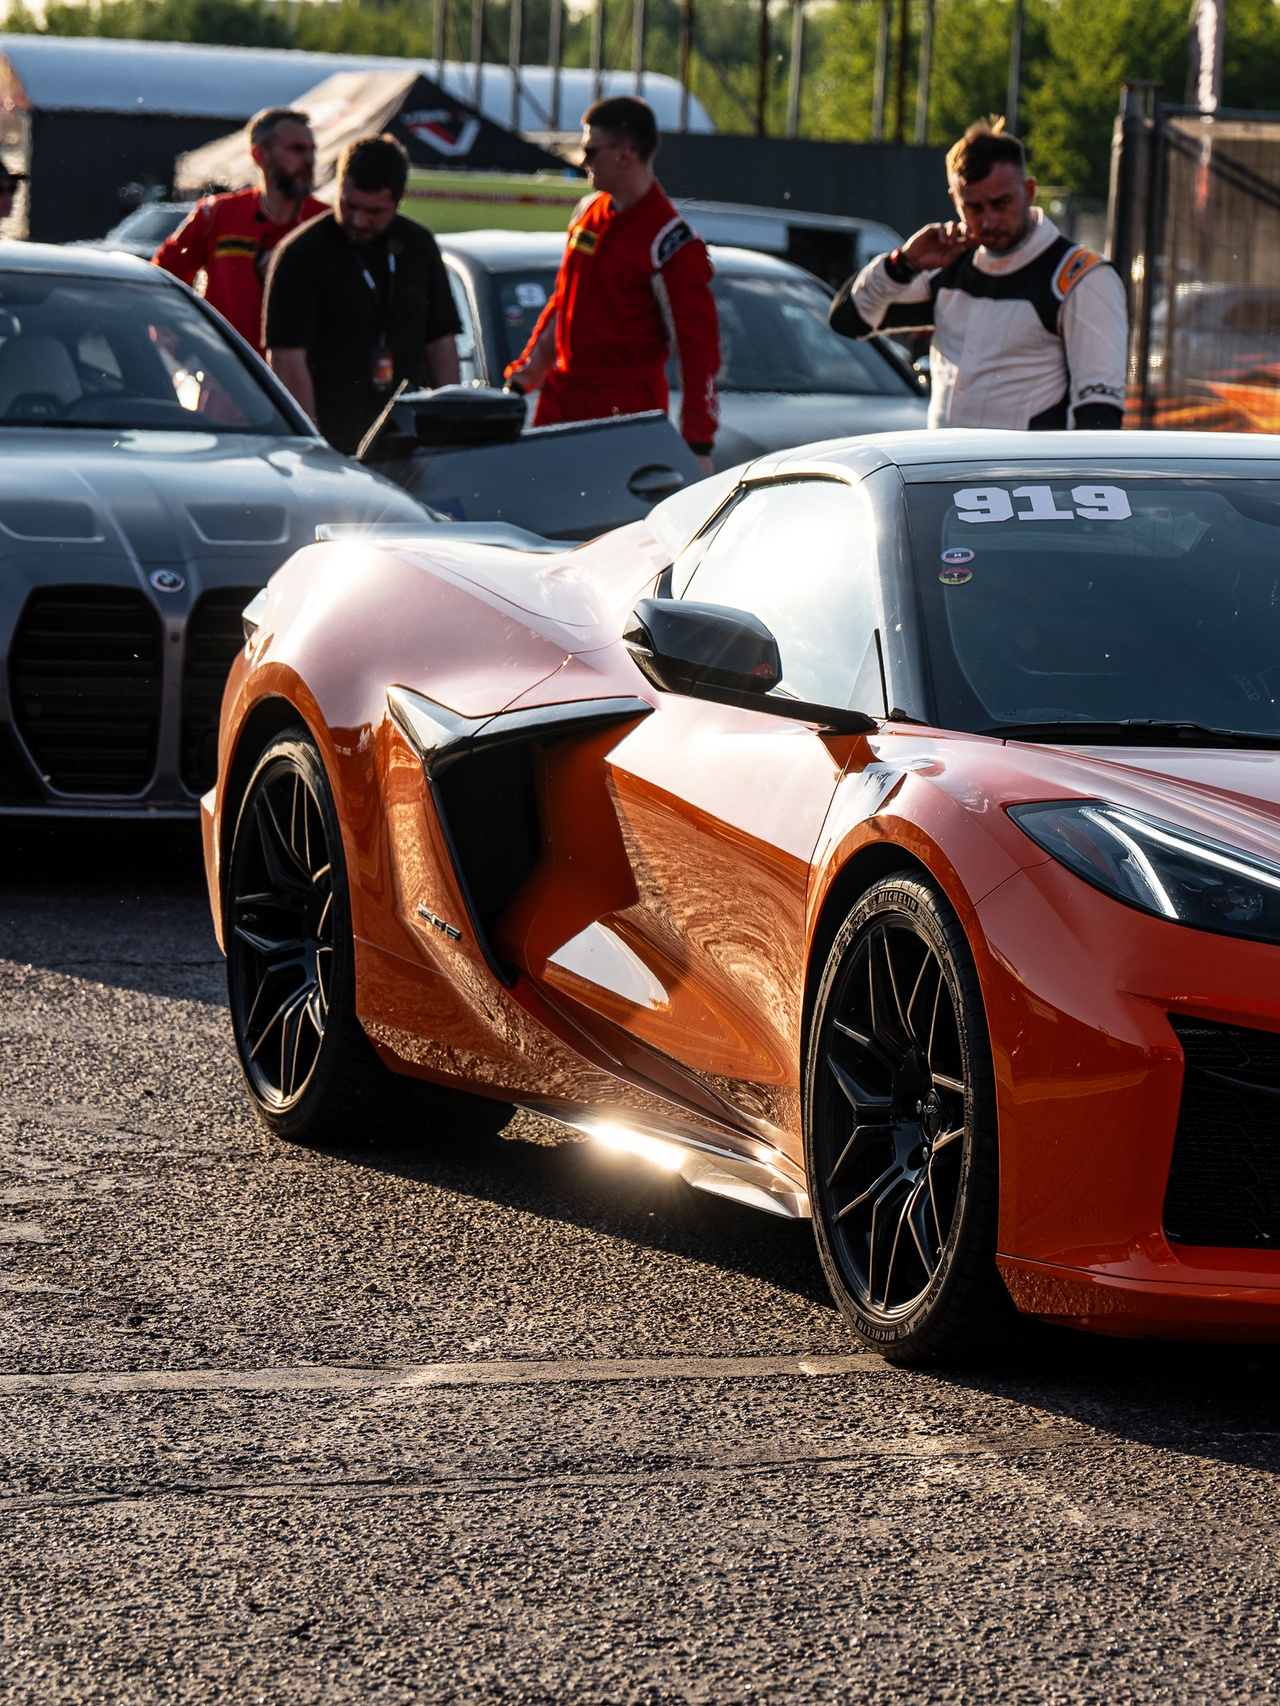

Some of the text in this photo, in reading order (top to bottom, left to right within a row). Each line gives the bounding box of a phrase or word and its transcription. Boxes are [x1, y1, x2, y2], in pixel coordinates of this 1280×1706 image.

[953, 485, 1132, 523] 919
[877, 892, 918, 912] MICHELIN
[856, 1320, 897, 1341] MICHELIN
